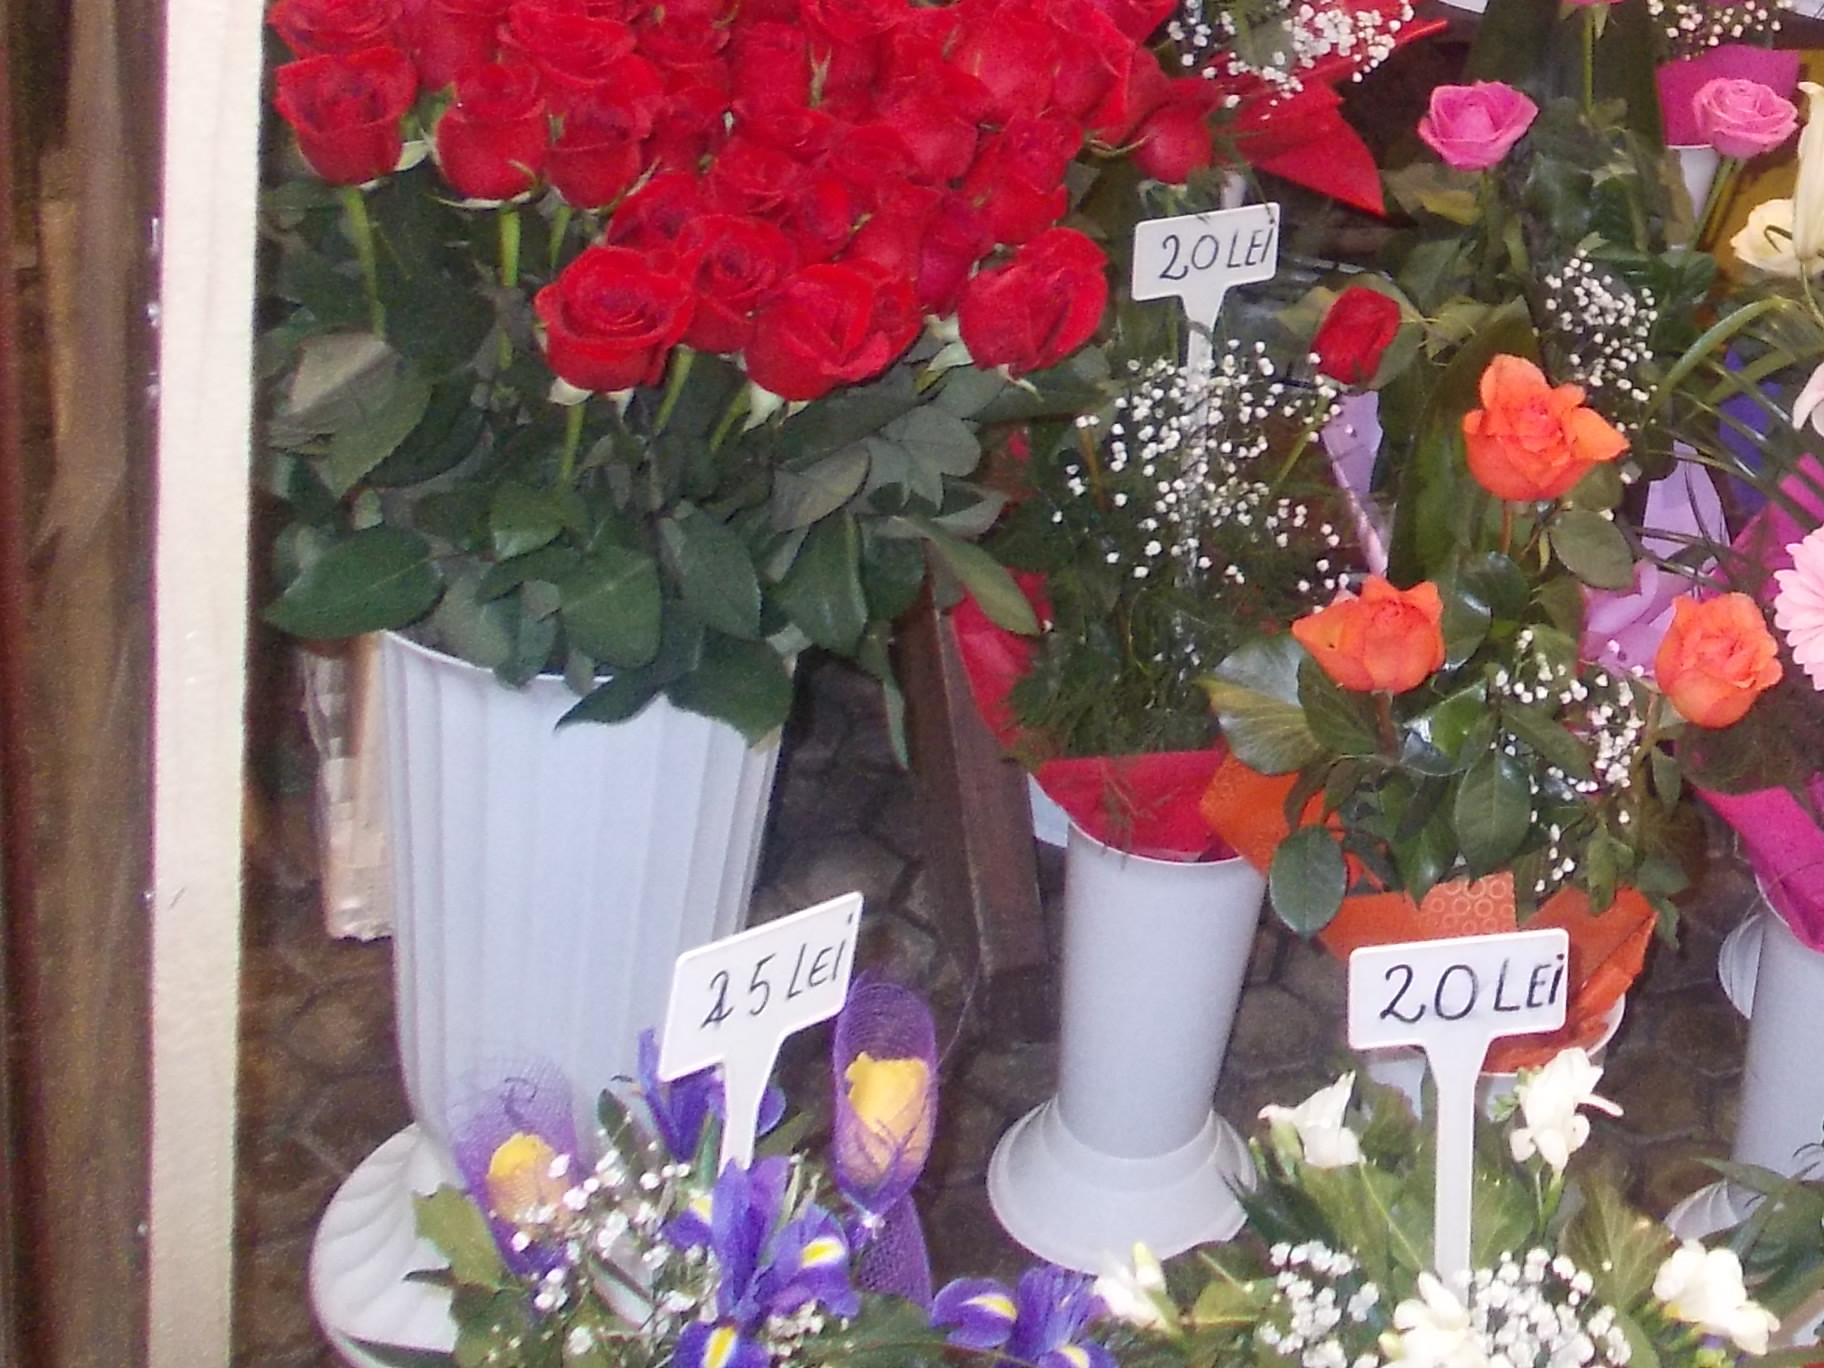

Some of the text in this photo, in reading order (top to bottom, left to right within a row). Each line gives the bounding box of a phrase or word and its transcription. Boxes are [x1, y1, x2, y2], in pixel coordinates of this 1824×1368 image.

[1158, 233, 1219, 281] 20
[700, 952, 777, 1030] 25
[1379, 963, 1480, 1024] 20
